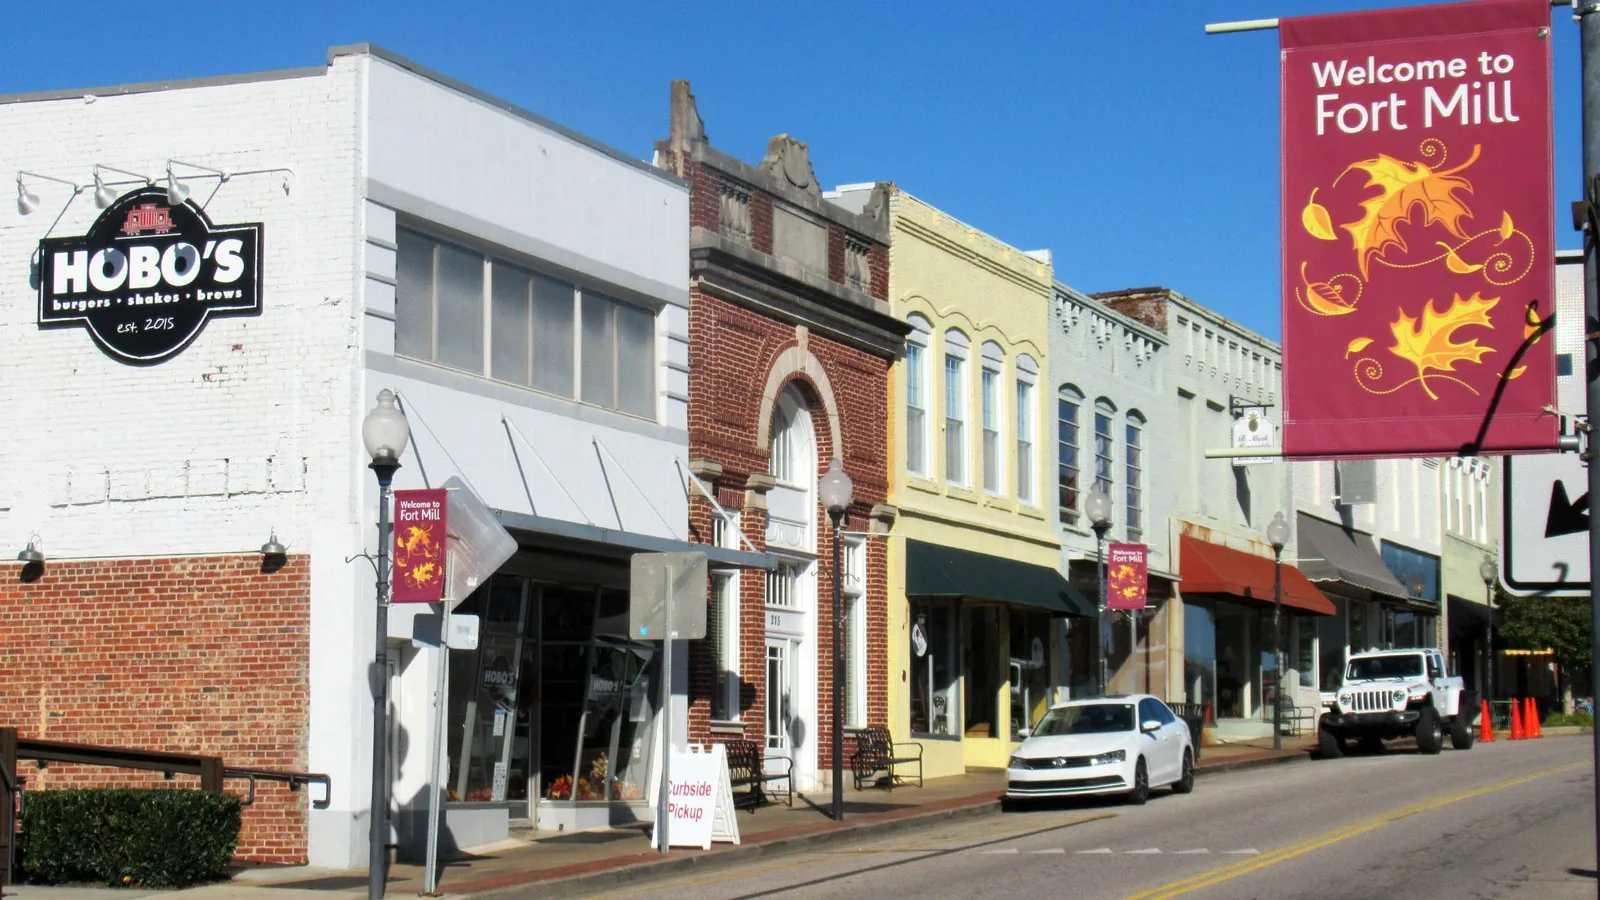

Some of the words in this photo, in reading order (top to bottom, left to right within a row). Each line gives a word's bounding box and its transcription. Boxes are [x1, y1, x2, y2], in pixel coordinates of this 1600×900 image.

[1311, 55, 1467, 88] Welcome
[1478, 51, 1514, 75] to
[1315, 92, 1408, 136] Fort
[1424, 80, 1520, 129] Mill
[53, 239, 245, 294] HOBO'S
[53, 299, 111, 312] burgers
[127, 292, 180, 307] shakes
[196, 288, 243, 301] brews
[116, 322, 139, 334] est.
[144, 316, 175, 331] 2015
[400, 510, 419, 520] Fort
[421, 509, 440, 520] Mill
[668, 803, 703, 823] Pickup
